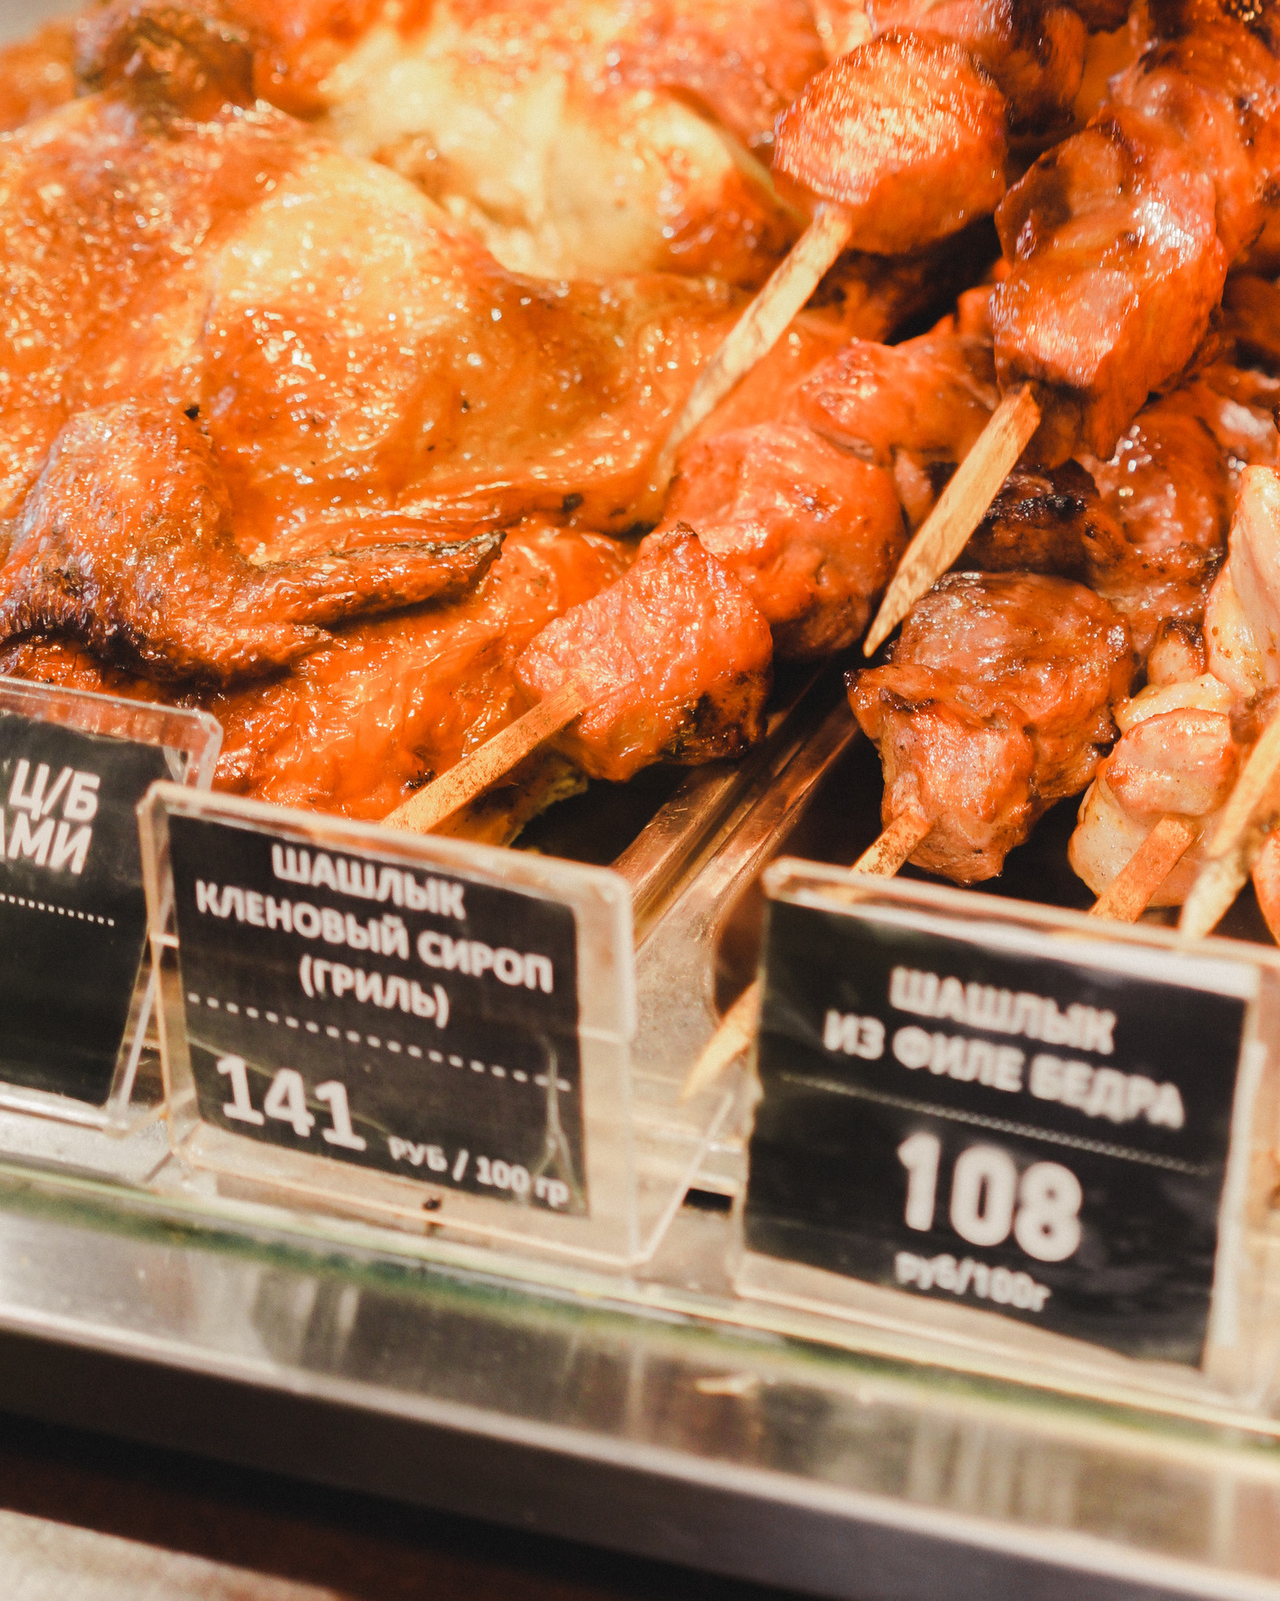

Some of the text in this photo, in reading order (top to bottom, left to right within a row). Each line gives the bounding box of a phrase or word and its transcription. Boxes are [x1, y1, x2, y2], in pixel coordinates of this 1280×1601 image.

[9, 759, 100, 821] Ц/Б
[0, 806, 92, 874] МИ
[272, 845, 466, 918] ШАШЛЫК
[195, 880, 554, 993] КЛЕНОВЫЙ СИРОП
[299, 954, 450, 1028] (ГРИЛЬ)
[890, 965, 1117, 1055] ШАШЛЫК
[216, 1054, 366, 1151] 141
[823, 1010, 1186, 1130] ИЗ ФИЛЕ БЕДРА
[476, 1155, 531, 1193] 100
[897, 1131, 1083, 1262] 108
